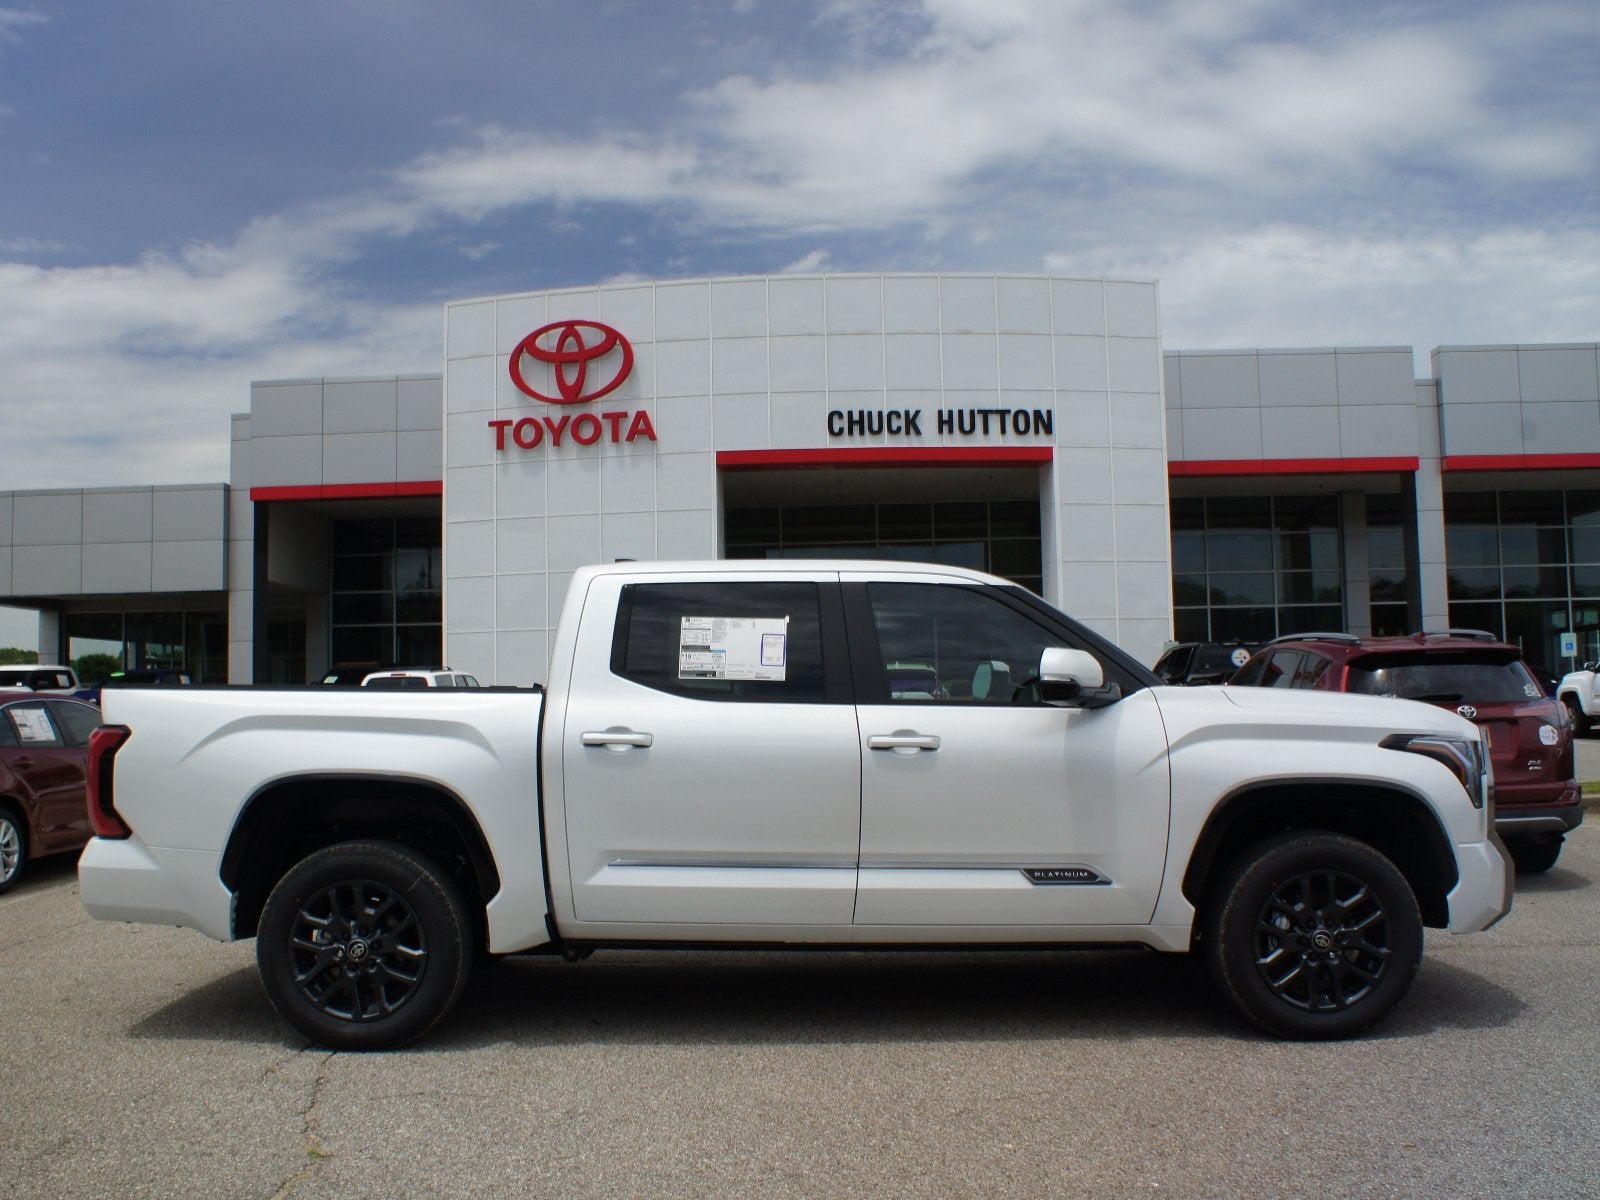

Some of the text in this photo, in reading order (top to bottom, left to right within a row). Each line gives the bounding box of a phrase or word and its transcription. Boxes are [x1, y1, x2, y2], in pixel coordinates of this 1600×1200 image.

[489, 410, 657, 450] TOYOTA
[828, 409, 1053, 437] CHUCK HUTTON
